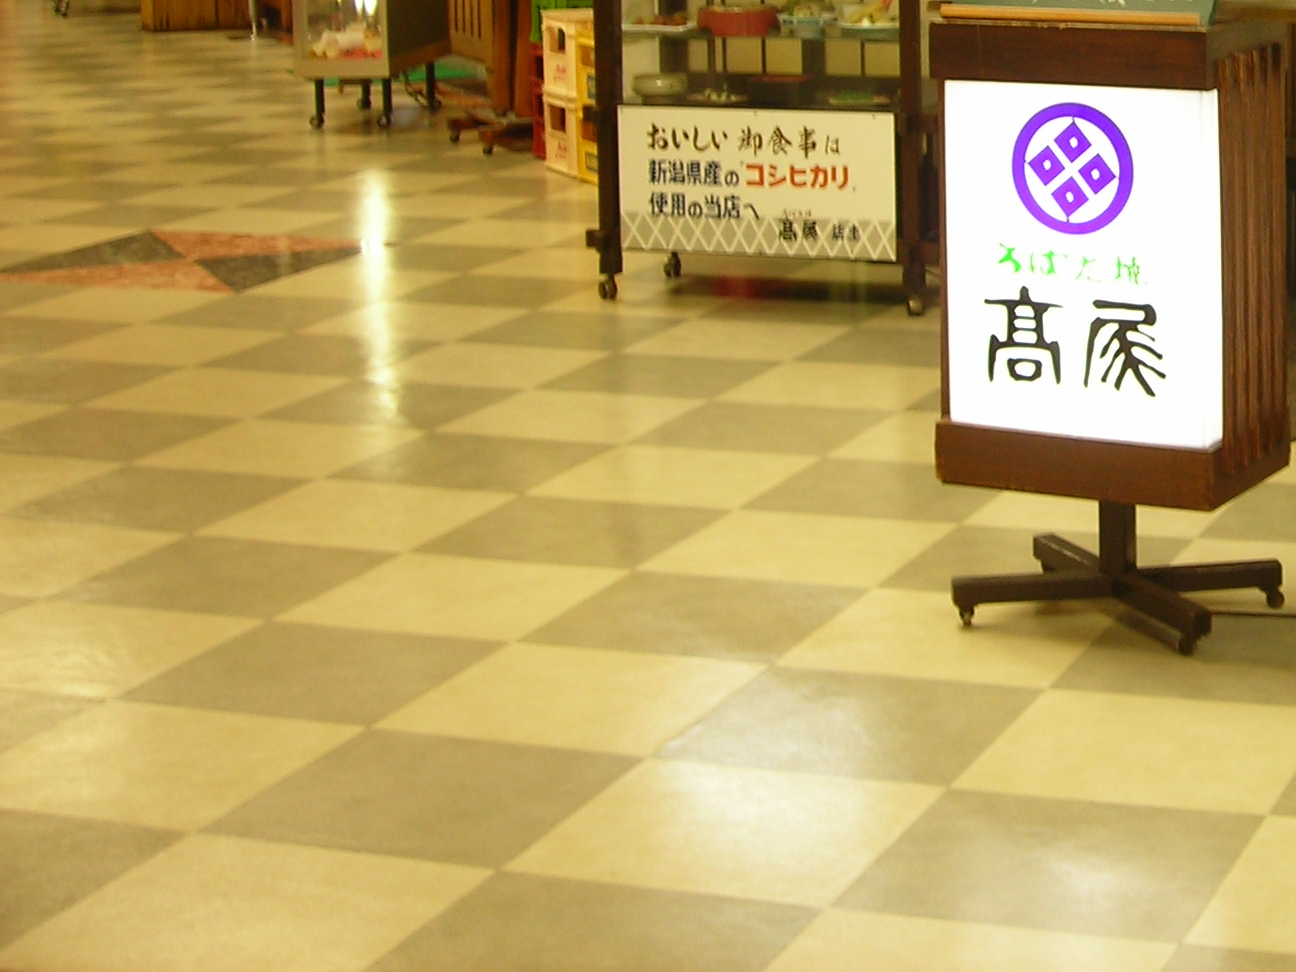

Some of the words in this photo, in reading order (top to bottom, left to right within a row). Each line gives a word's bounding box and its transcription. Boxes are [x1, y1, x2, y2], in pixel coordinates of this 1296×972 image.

[647, 122, 728, 152] おいしい
[738, 126, 840, 159] 御食事は
[650, 191, 760, 220] 使用の当店へ
